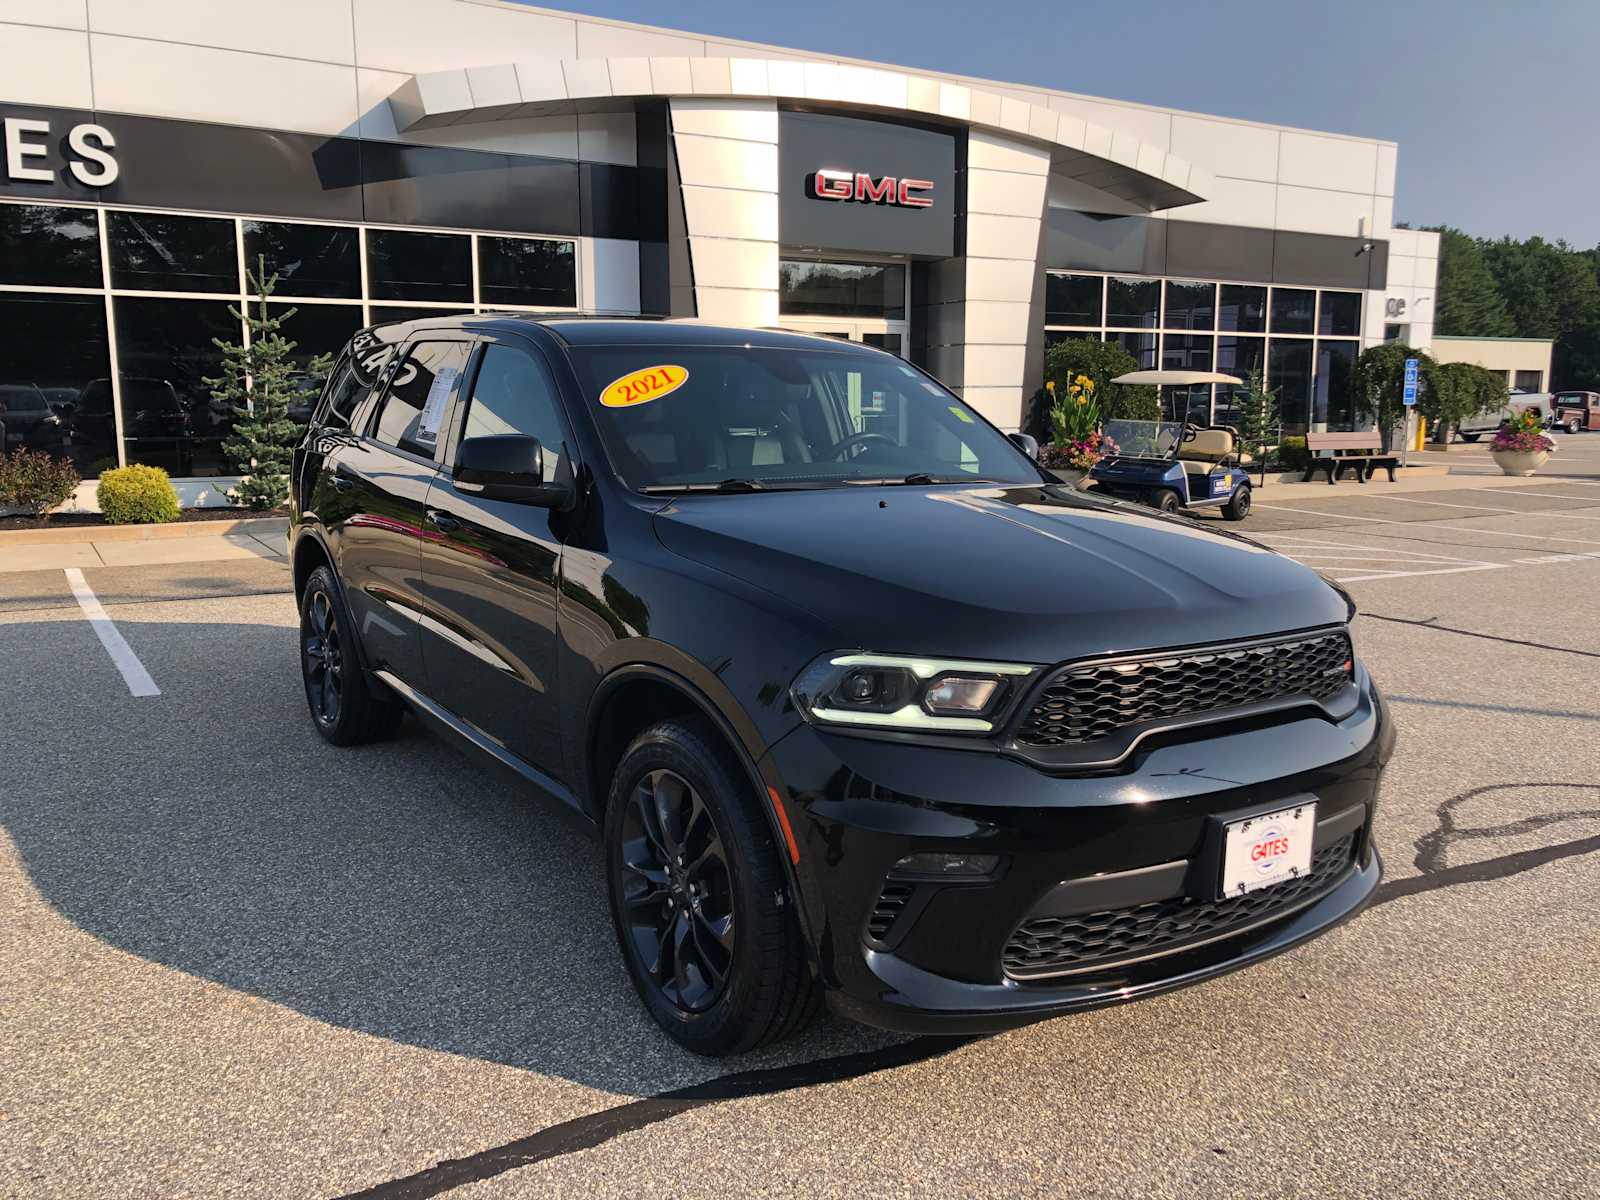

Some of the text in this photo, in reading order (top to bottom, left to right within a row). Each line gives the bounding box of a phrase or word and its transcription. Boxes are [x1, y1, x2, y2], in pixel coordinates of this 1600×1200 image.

[4, 117, 119, 187] ES
[815, 168, 935, 208] GMC
[617, 368, 674, 401] 2021
[1250, 838, 1289, 861] GATES
